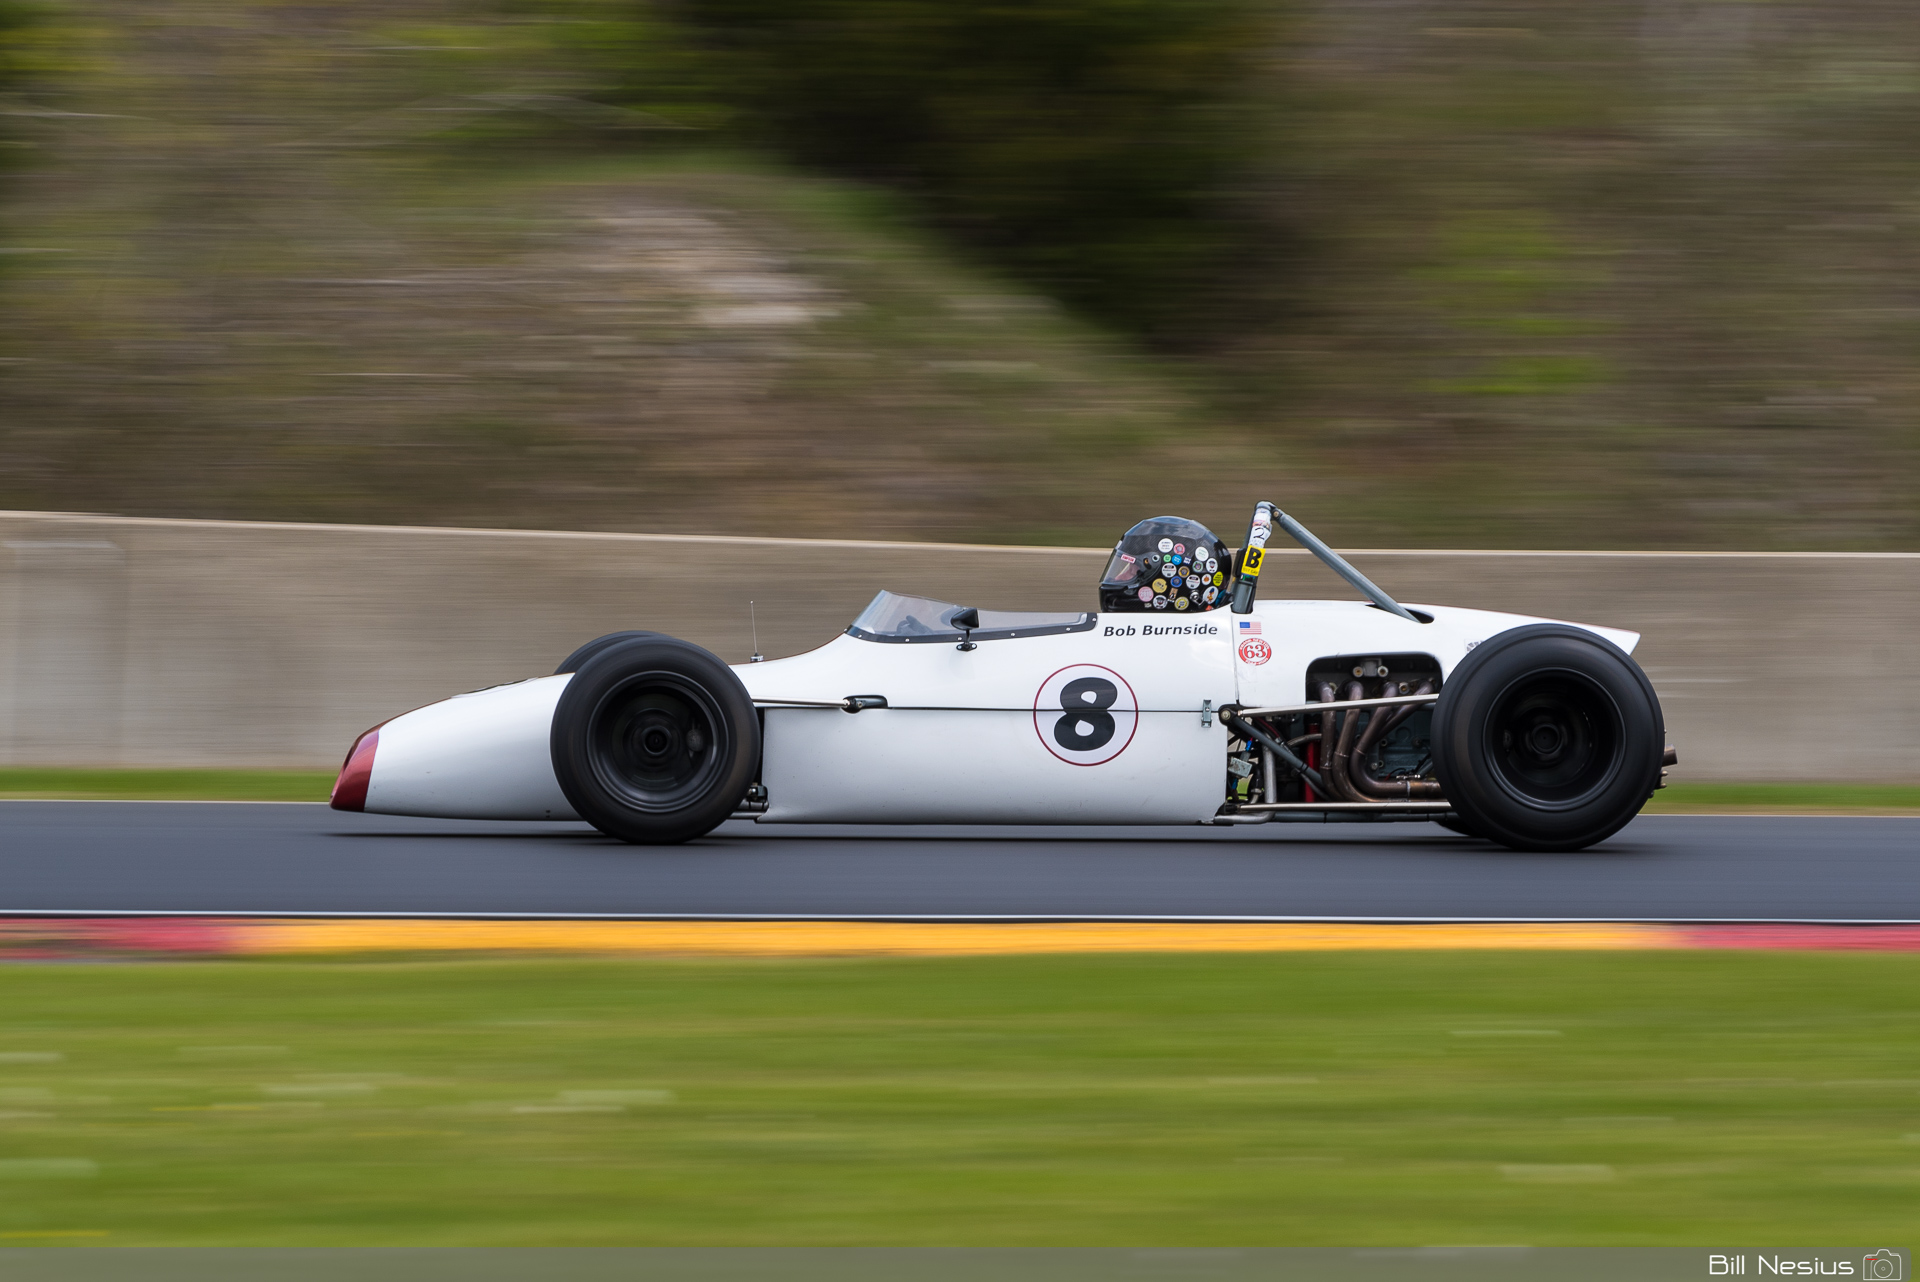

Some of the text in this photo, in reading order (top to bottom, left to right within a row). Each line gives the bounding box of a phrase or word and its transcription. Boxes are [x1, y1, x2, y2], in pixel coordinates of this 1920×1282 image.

[1253, 527, 1265, 541] 2
[1246, 547, 1262, 569] B
[1103, 623, 1218, 637] Bob Burnside
[1243, 644, 1267, 659] 63
[1053, 676, 1118, 752] 8
